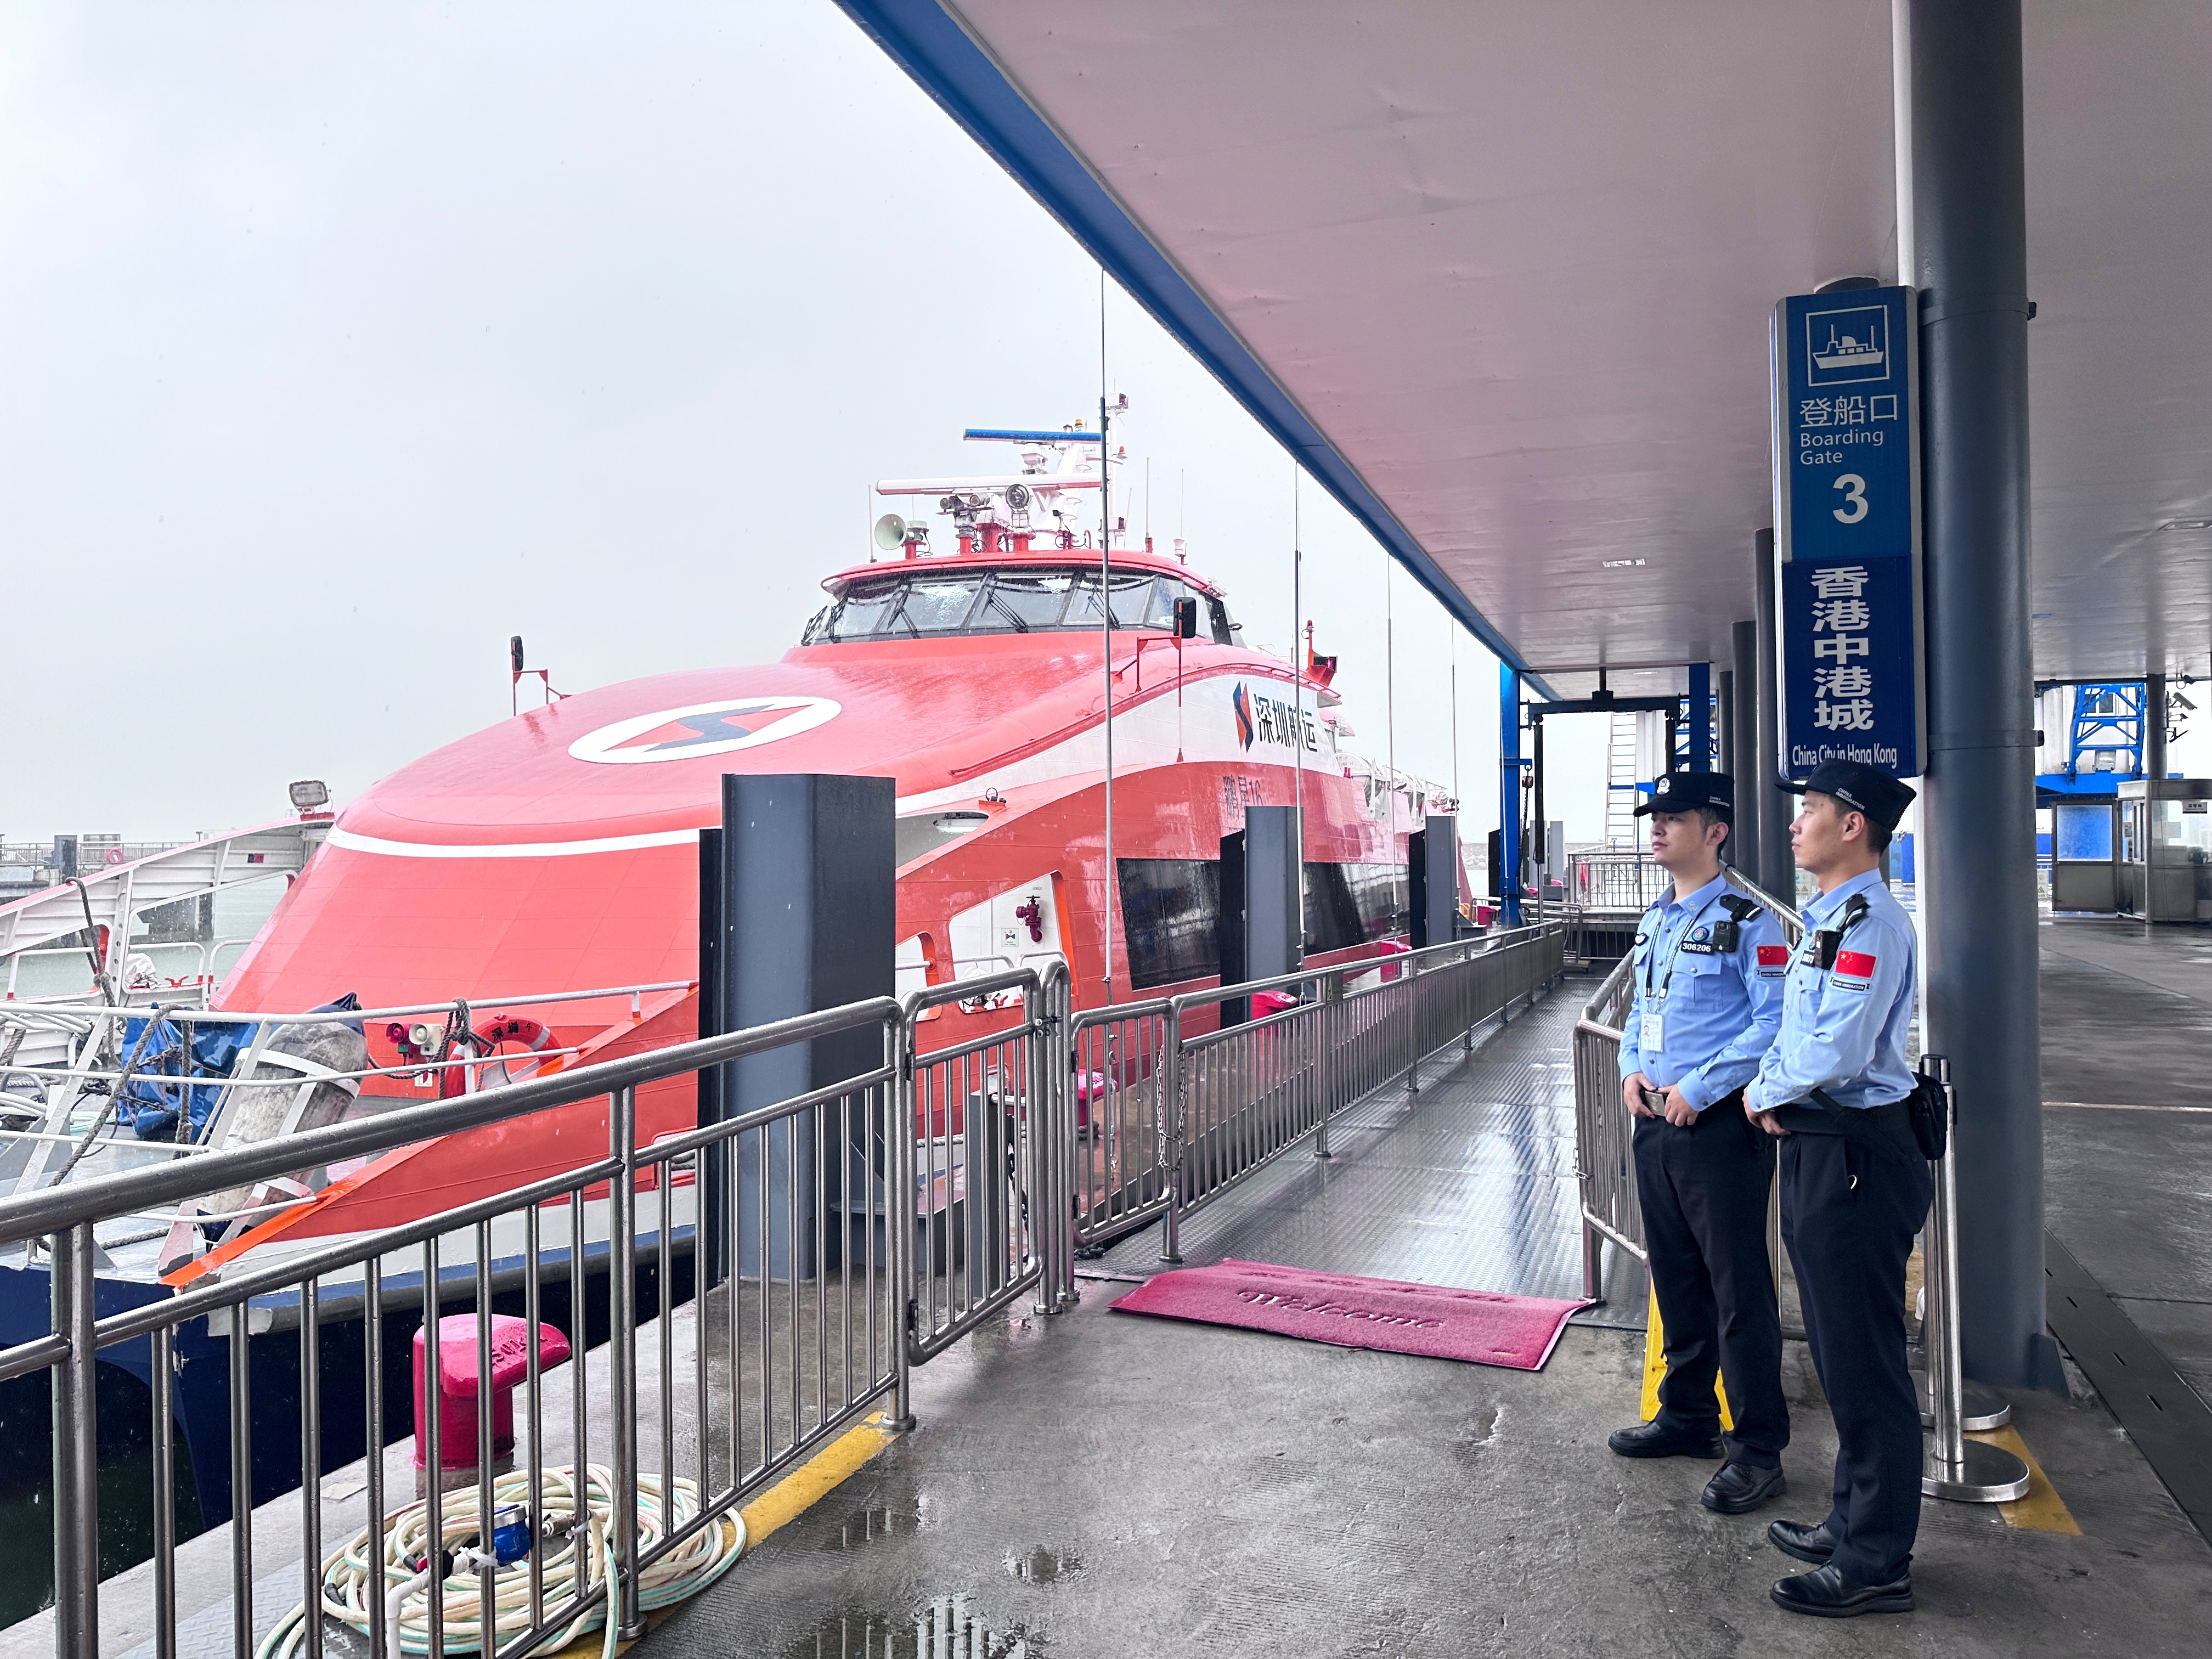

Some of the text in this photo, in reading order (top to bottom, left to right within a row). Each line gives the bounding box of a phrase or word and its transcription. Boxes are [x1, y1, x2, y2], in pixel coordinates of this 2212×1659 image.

[1800, 394, 1898, 428] 登船口
[1801, 429, 1884, 447] Boarding
[1800, 450, 1843, 465] Gate
[1832, 473, 1869, 524] 3
[1810, 566, 1874, 731] 香港中港城
[1792, 744, 1817, 766] China
[1837, 743, 1846, 760] in
[1847, 744, 1872, 765] Hong
[1874, 743, 1897, 769] Kong
[1835, 791, 1865, 810] IMMIGRATION
[1838, 787, 1852, 798] CHINA
[1682, 943, 1711, 952] 306206
